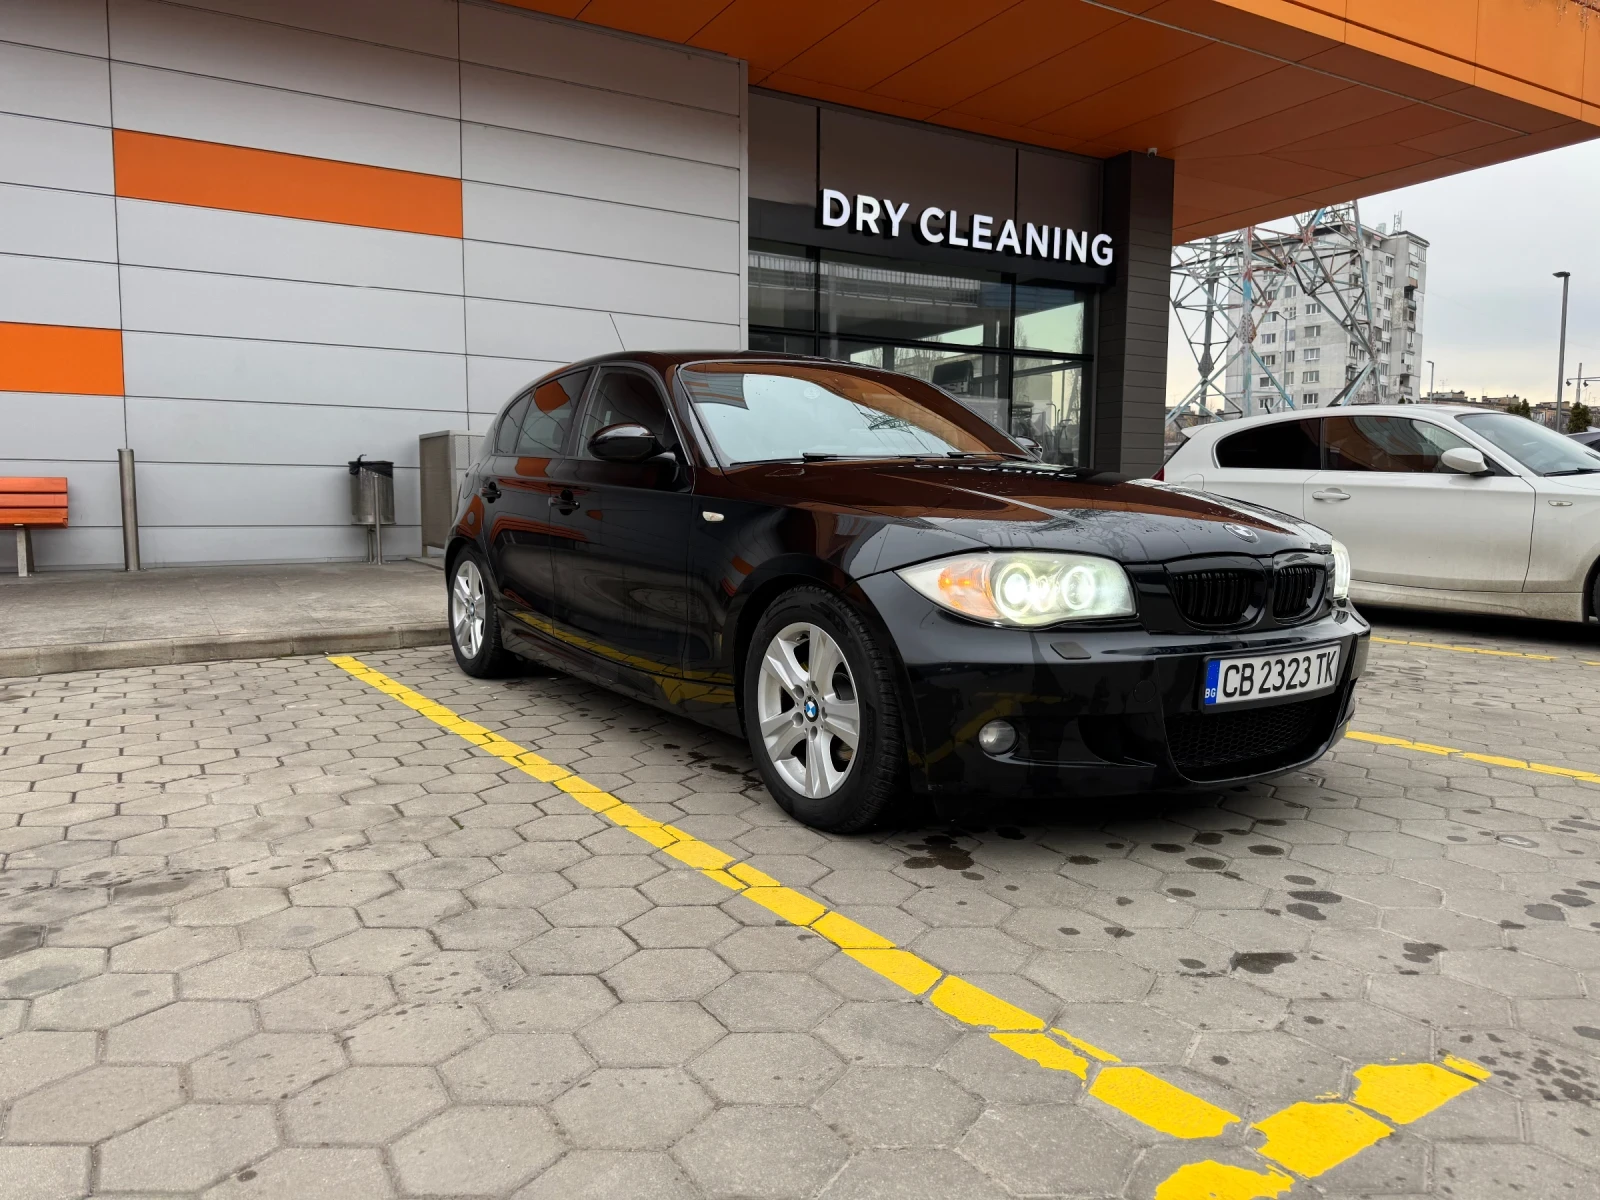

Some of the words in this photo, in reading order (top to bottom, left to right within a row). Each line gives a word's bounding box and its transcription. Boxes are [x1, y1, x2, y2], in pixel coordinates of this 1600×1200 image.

[821, 188, 910, 237] DRY
[918, 206, 1114, 267] CLEANING
[1204, 687, 1217, 699] BG
[1222, 663, 1255, 698] CB
[1258, 656, 1312, 694] 2323
[1316, 650, 1337, 685] TK
